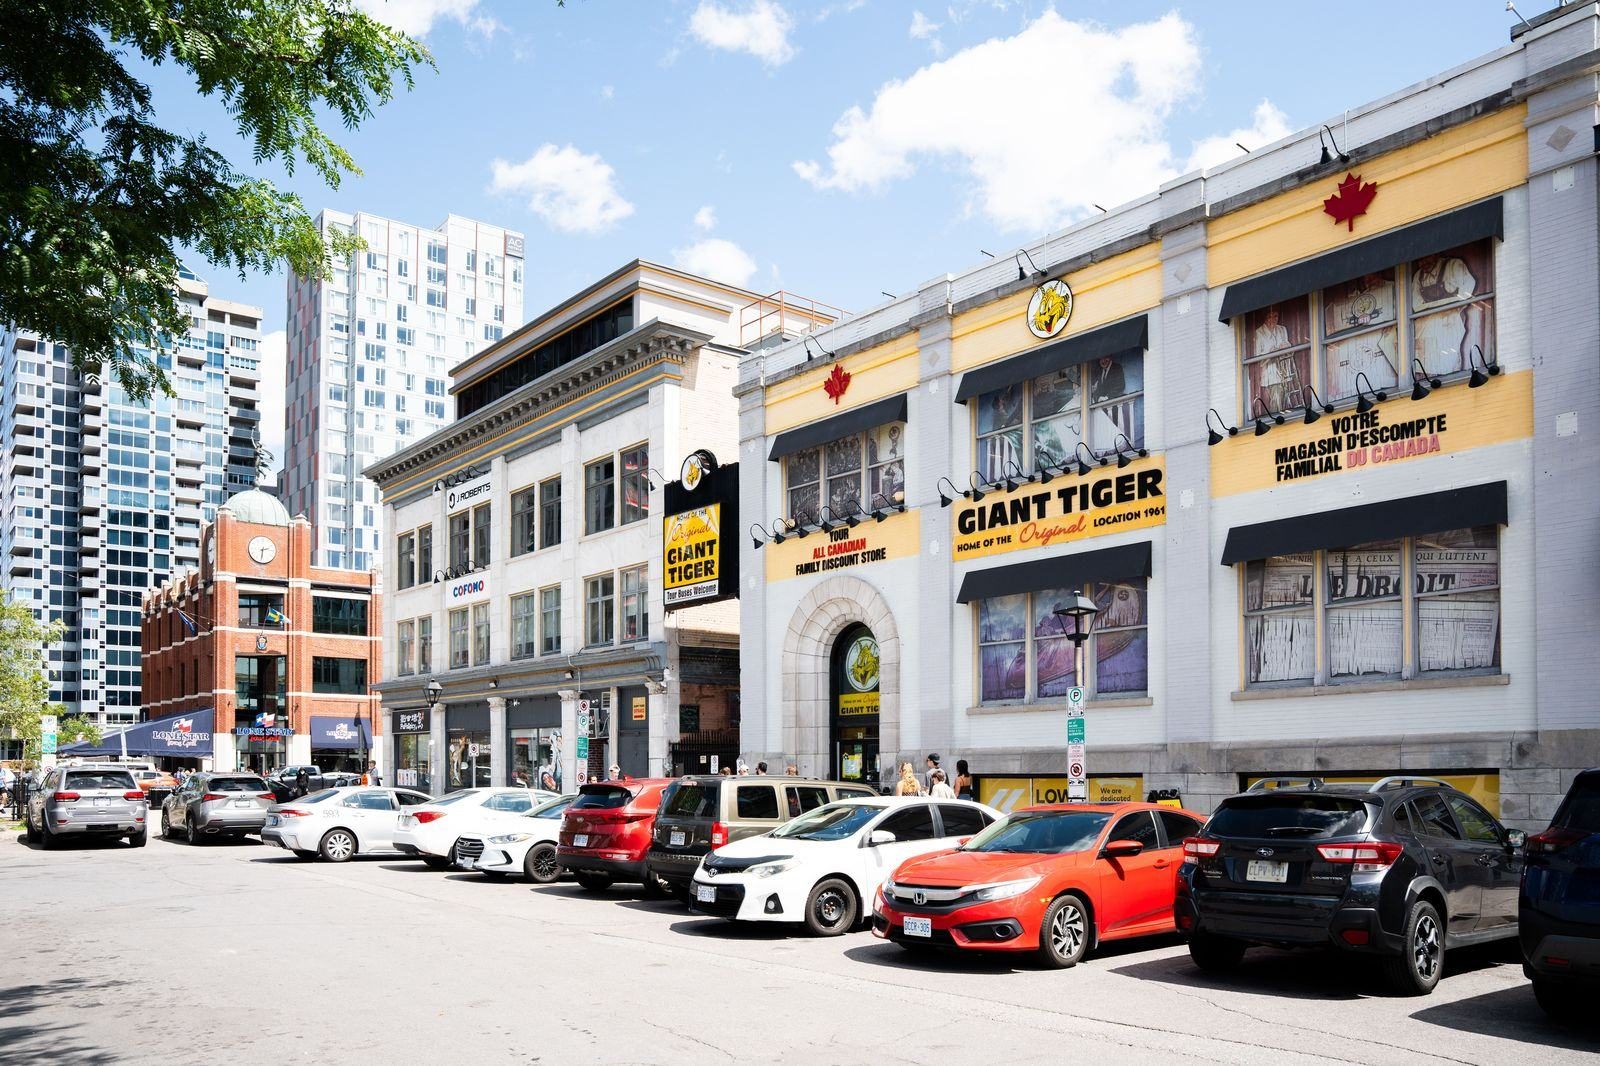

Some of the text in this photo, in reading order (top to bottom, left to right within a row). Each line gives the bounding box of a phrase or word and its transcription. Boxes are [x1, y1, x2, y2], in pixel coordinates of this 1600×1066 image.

[1331, 410, 1379, 435] VOTRE
[1275, 414, 1447, 465] MAGASIN D'ESCOMPTE
[1276, 434, 1441, 482] FAMILIAL DU CANADA
[460, 482, 491, 502] ROBERTS
[957, 468, 1163, 535] GIANT TIGER
[677, 512, 690, 521] HOME
[698, 508, 707, 516] THE
[672, 517, 712, 544] Original
[829, 528, 849, 542] YOUR
[957, 505, 1165, 552] HOME OF THE Original LOCATION 1961
[667, 539, 717, 565] GIANT
[813, 538, 867, 559] ALL CANADIAN
[1366, 554, 1393, 562] CEUX
[1416, 552, 1433, 560] QUI
[1438, 552, 1488, 560] LUTTENT
[668, 559, 715, 583] TIGER
[796, 547, 886, 576] FAMILY DISCOUNT STORE
[453, 580, 484, 597] COFOMO
[667, 583, 717, 600] Tour Buses Welcome
[841, 705, 879, 715] GIANT TIG
[153, 731, 210, 741] LONE STAR
[236, 727, 293, 736] LONE STAR
